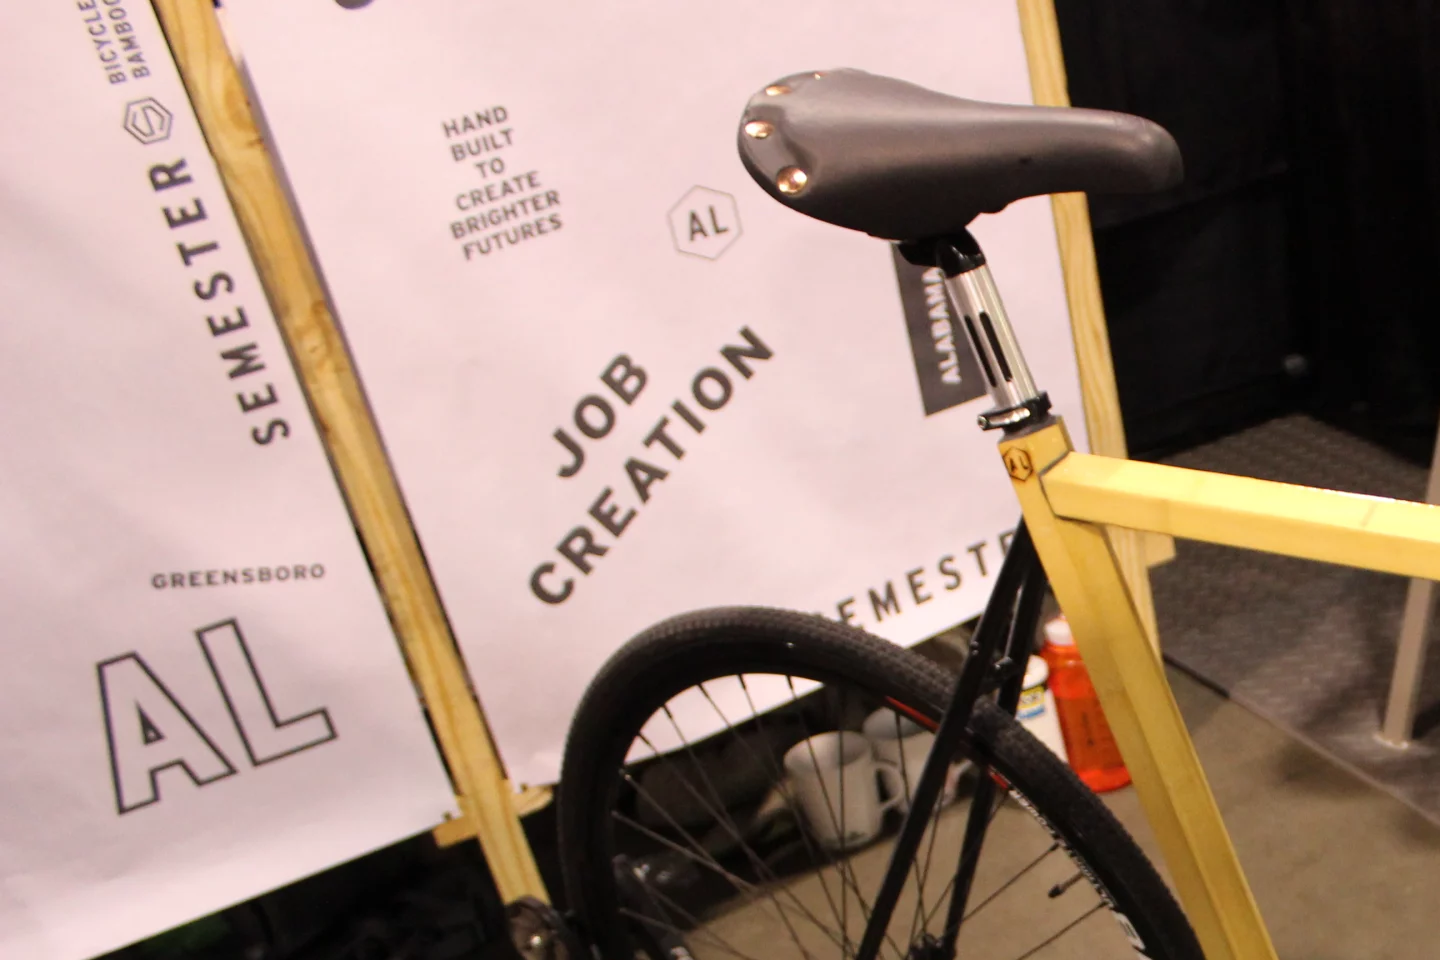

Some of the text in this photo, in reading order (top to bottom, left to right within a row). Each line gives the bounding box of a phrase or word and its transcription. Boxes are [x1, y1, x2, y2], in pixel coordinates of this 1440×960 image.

[442, 105, 508, 138] HAND
[450, 128, 513, 162] BUILT
[456, 170, 541, 212] CREATE
[475, 157, 505, 179] TO
[450, 190, 560, 239] BRIGHTER
[462, 213, 563, 261] FUTURES
[688, 204, 729, 242] AL
[148, 157, 291, 446] SEMESTER
[920, 266, 962, 385] ALABAMA
[551, 352, 649, 480] JOB
[528, 324, 774, 606] CREATION
[151, 564, 326, 590] GREENSBORO
[834, 528, 1018, 629] EMESTE
[96, 618, 339, 815] AL
